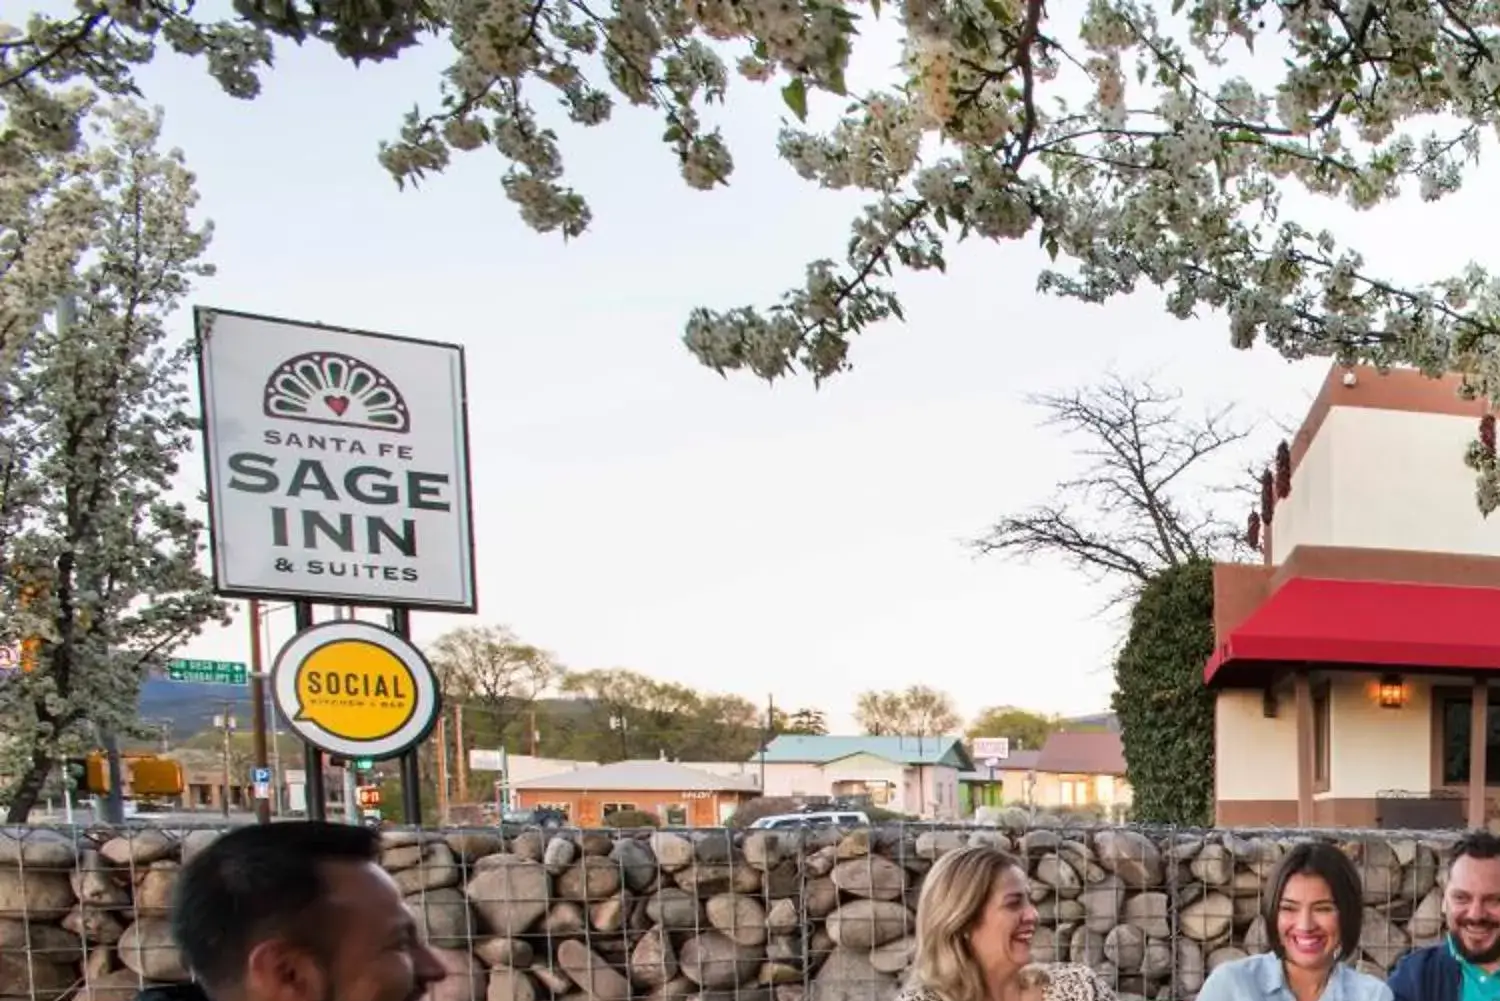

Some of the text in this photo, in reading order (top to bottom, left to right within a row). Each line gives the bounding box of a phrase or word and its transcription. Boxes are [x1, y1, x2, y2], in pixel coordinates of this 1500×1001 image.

[264, 429, 413, 461] SANTA FE
[227, 452, 451, 513] SAGE
[271, 507, 417, 557] INN
[274, 557, 418, 582] & SUITES
[307, 671, 406, 699] SOCIAL
